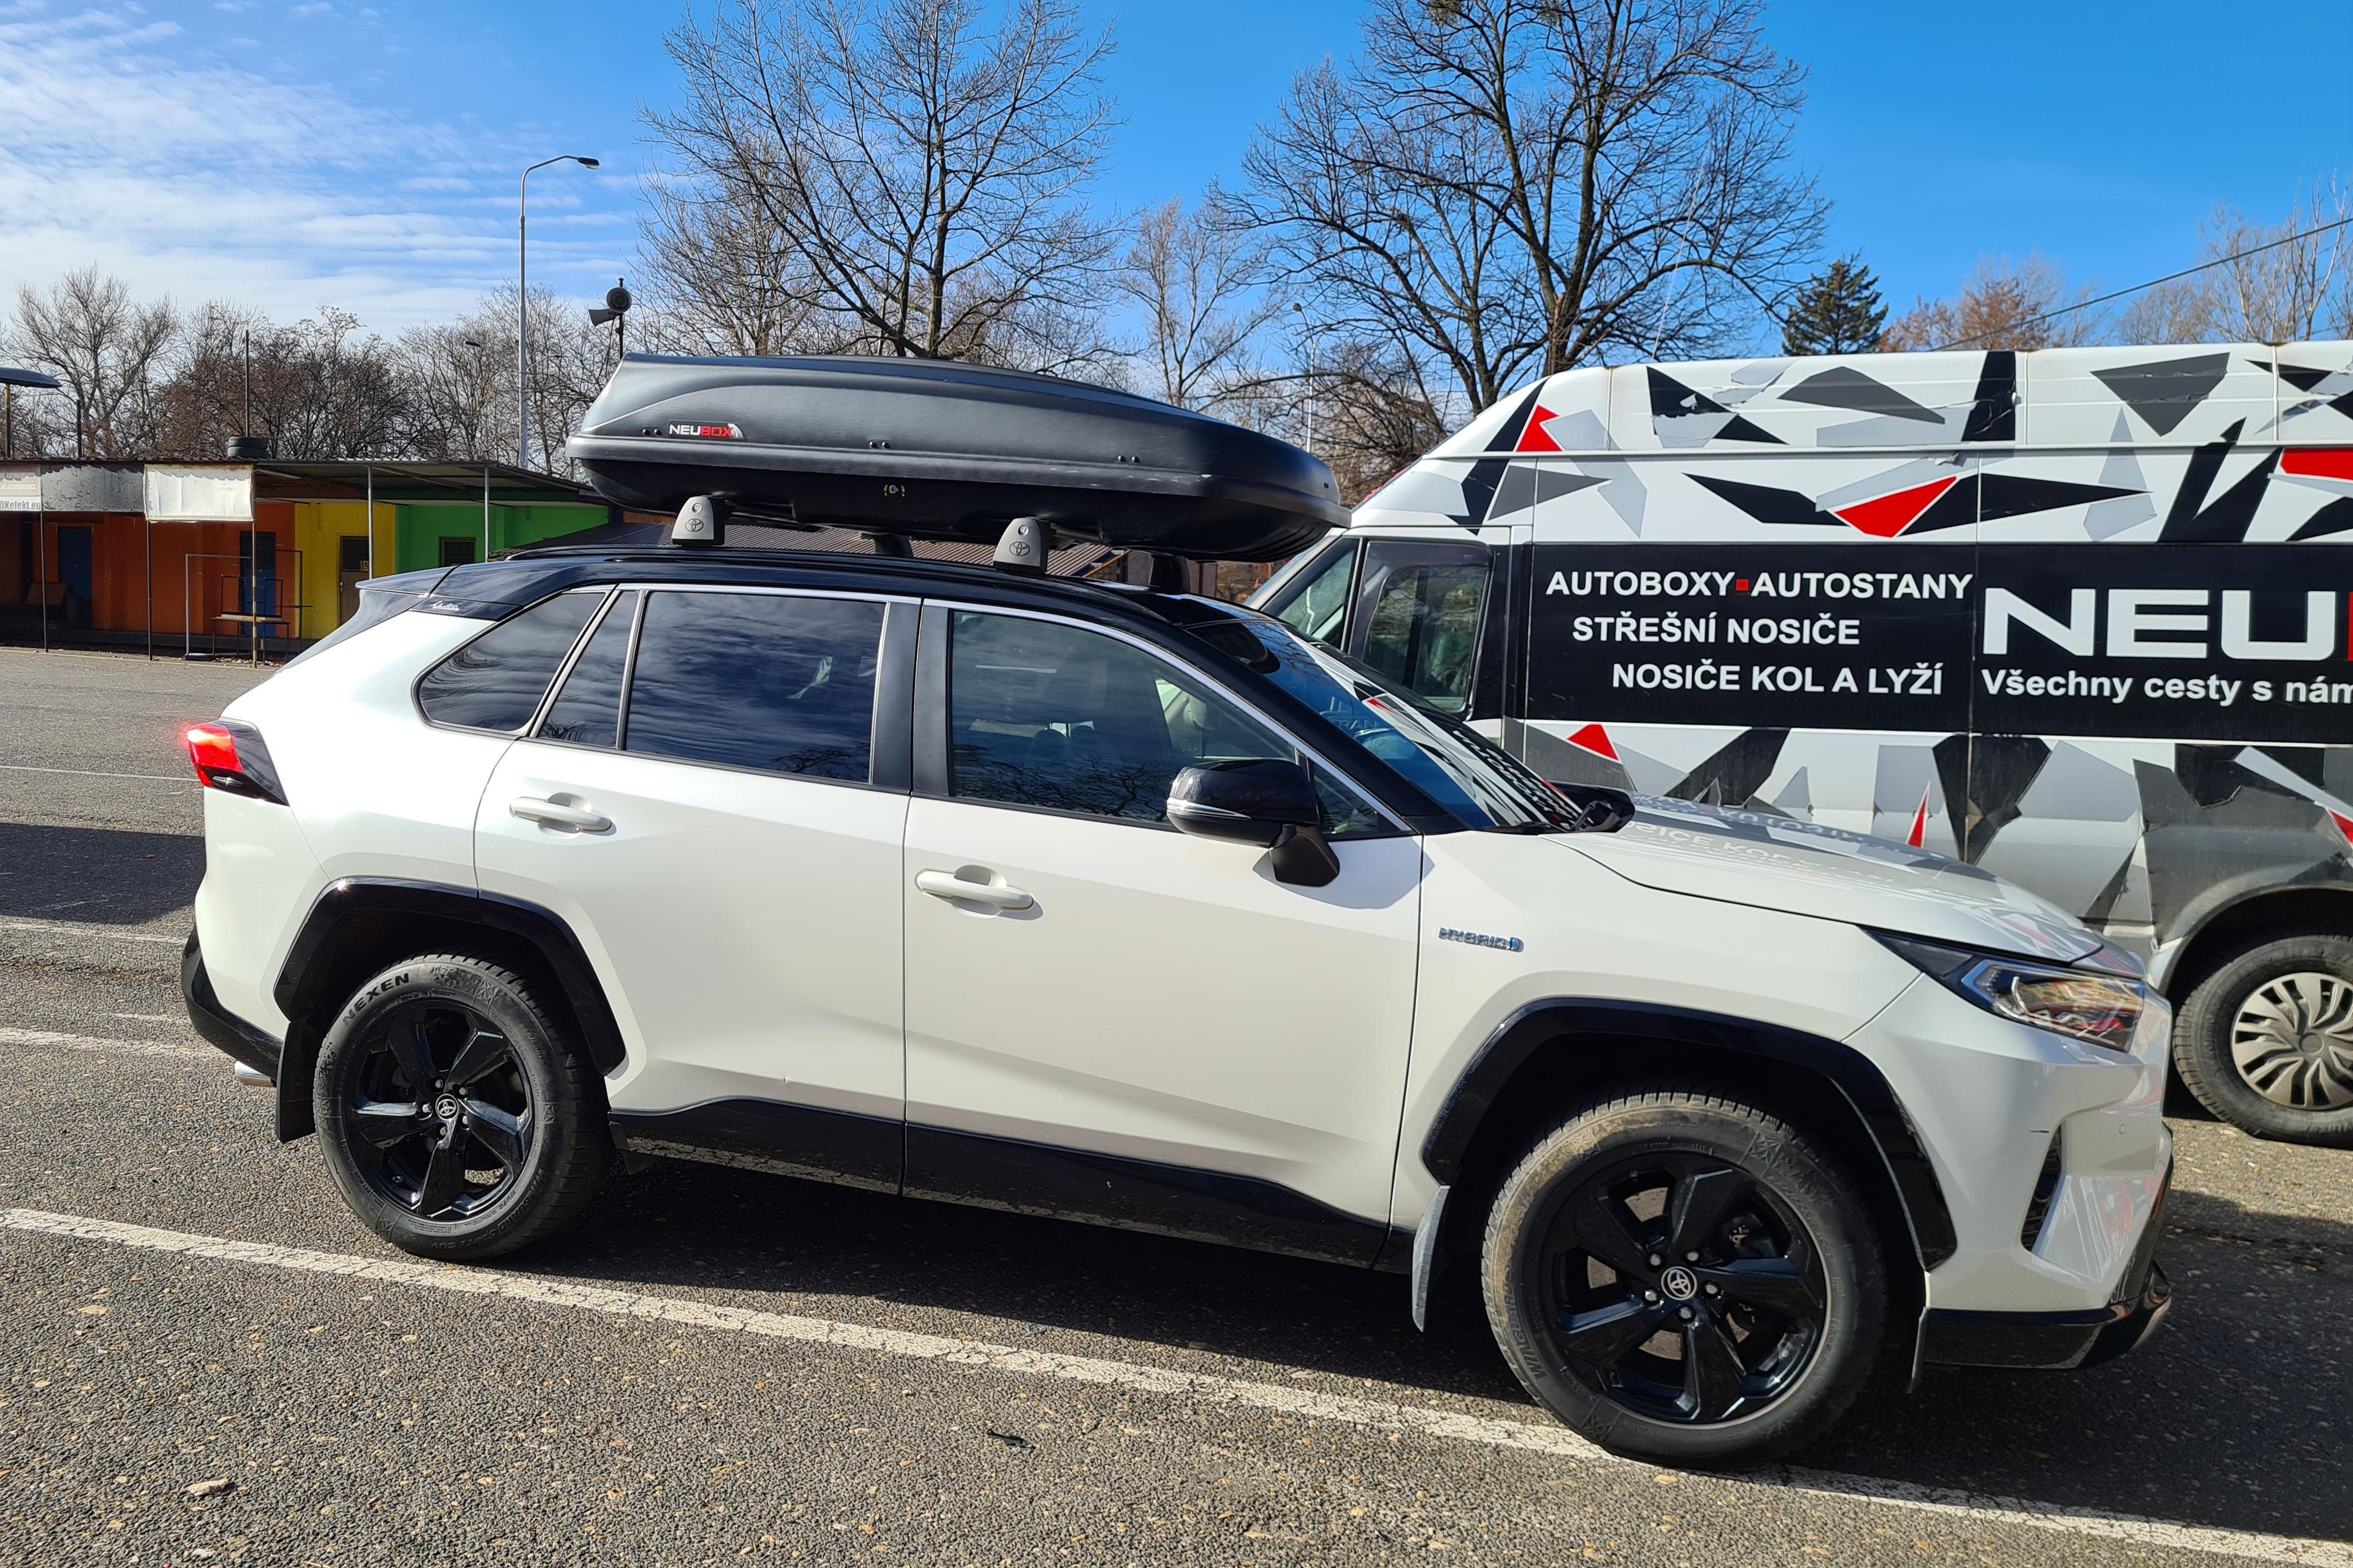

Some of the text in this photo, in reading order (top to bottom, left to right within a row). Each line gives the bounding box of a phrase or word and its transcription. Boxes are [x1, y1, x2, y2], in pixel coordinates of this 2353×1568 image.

[669, 424, 734, 439] NEUBOX
[1545, 571, 1973, 599] AUTOBOXY AUTOSTANY
[1572, 610, 1860, 645] STŘEŠNÍ NOSIČE
[1982, 588, 2353, 662] NEU
[1612, 658, 1944, 695] NOSIČE KOL A LYŽÍ
[1981, 669, 2133, 703] Všechny
[2144, 674, 2241, 707] cesty
[2252, 680, 2272, 701] s
[343, 973, 409, 1026] NEXEN
